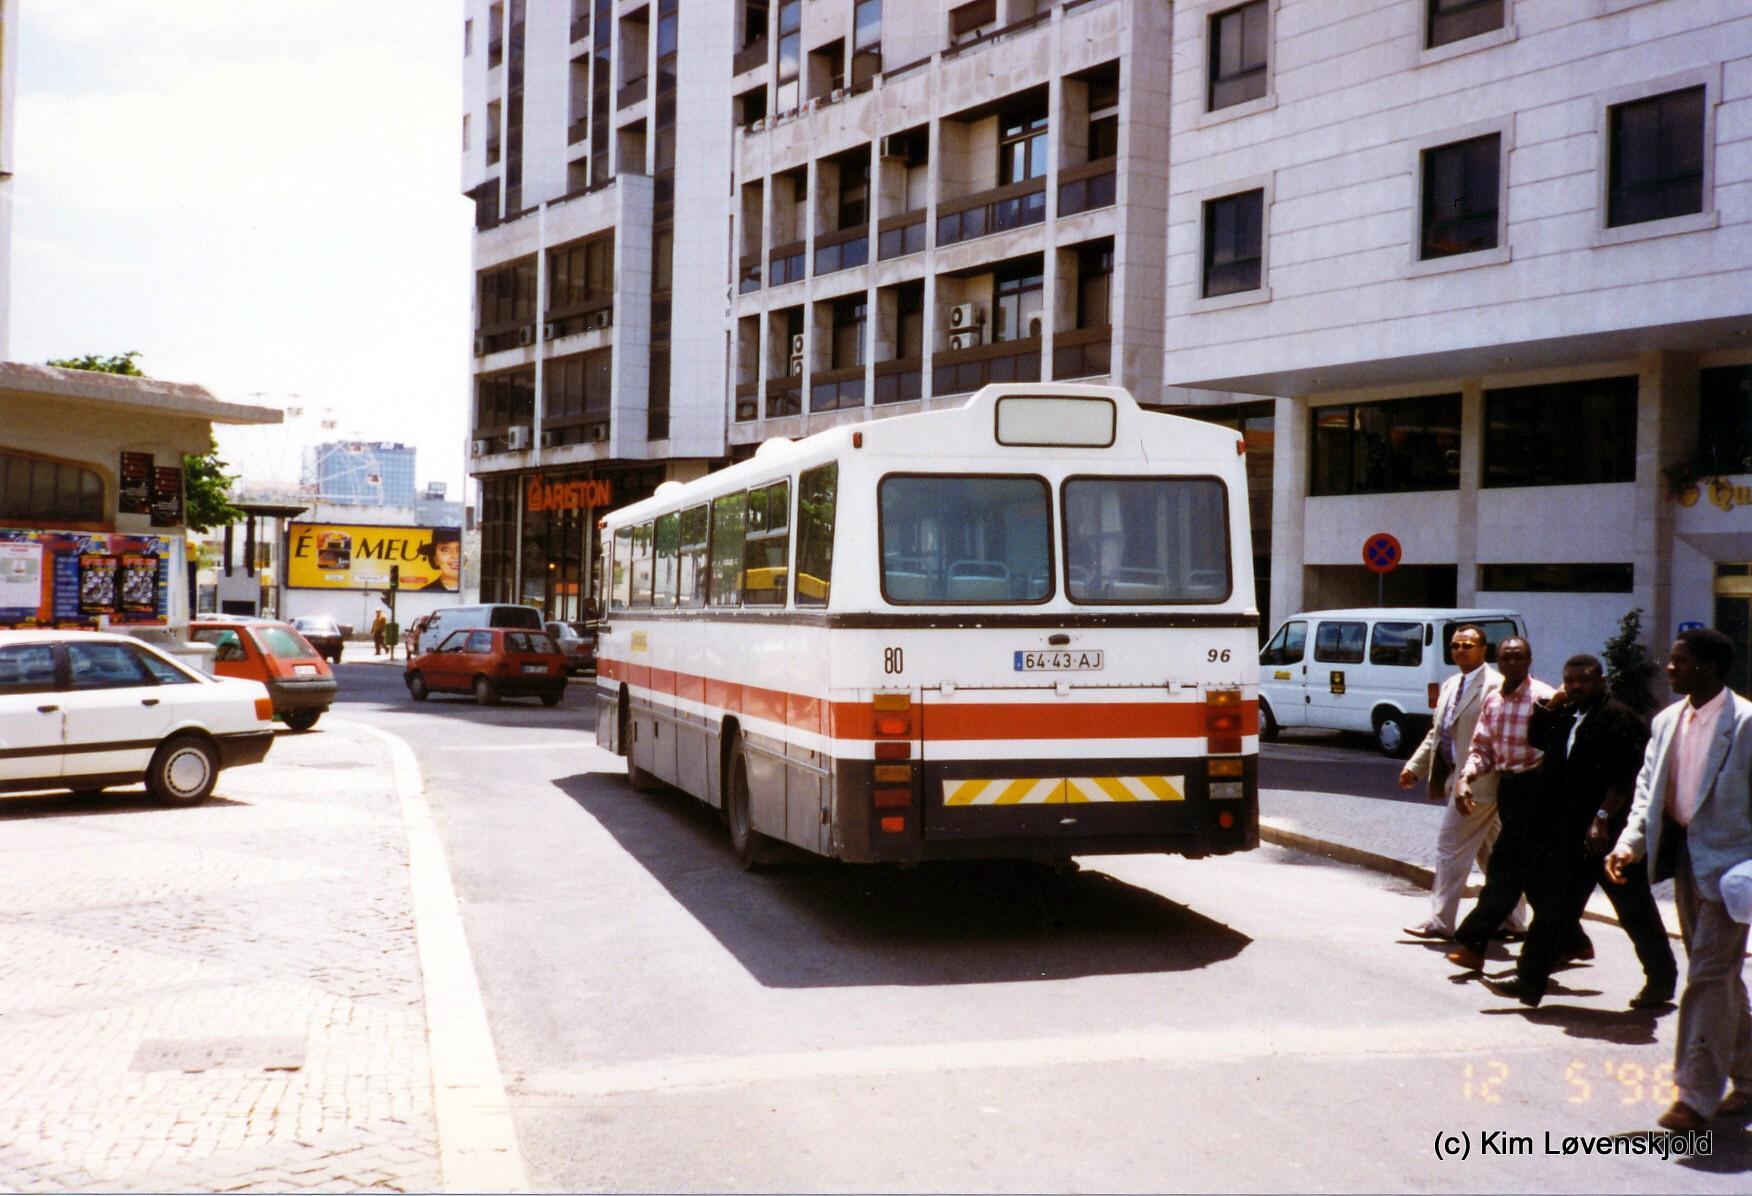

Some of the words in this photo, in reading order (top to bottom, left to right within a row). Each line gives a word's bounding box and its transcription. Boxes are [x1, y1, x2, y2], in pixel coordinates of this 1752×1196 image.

[543, 479, 613, 512] ARISTON
[294, 528, 313, 558] É
[884, 647, 904, 674] 80
[1207, 648, 1231, 663] 96
